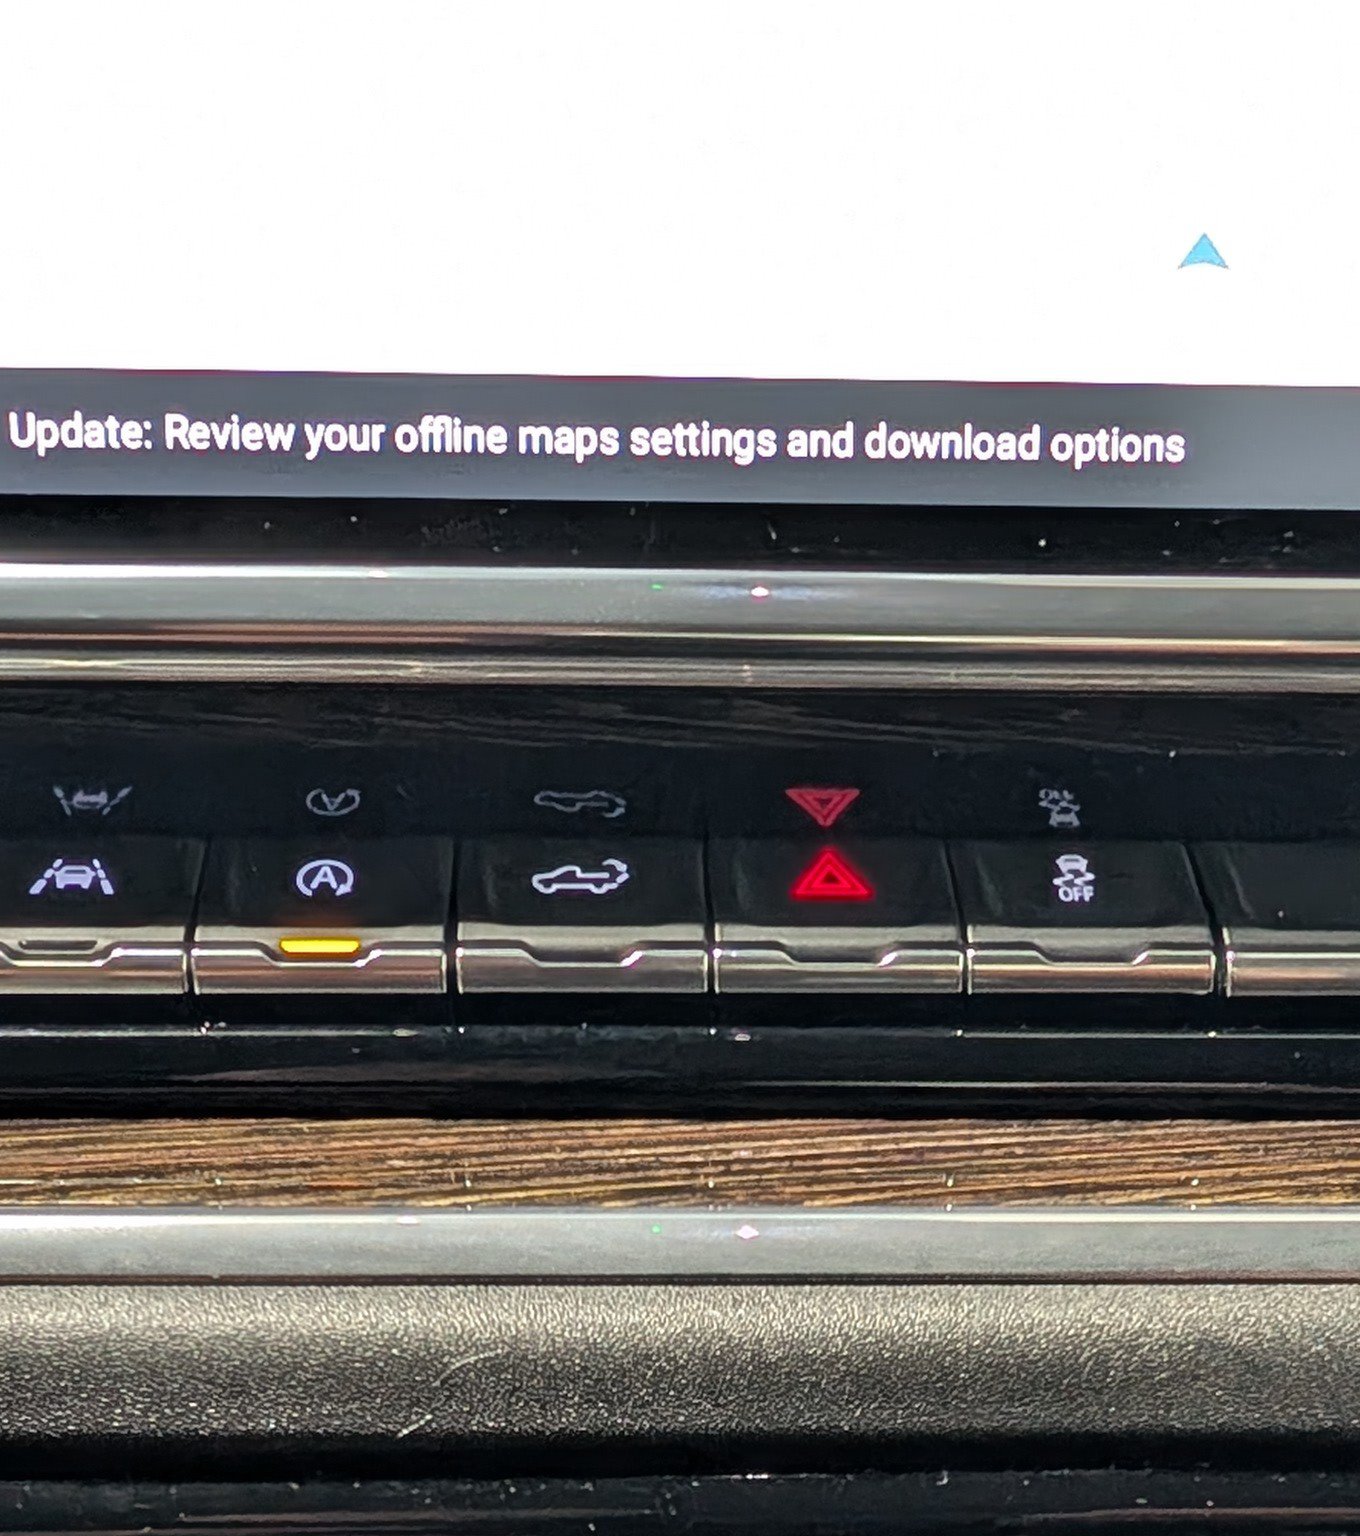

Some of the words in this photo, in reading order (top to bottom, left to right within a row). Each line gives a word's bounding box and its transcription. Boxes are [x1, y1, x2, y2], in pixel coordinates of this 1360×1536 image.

[8, 409, 153, 457] Update:
[164, 412, 297, 452] Review
[303, 422, 387, 461] your
[394, 414, 508, 455] offline
[518, 425, 620, 464] maps
[629, 420, 778, 466] settings
[786, 420, 854, 459] and
[864, 420, 1041, 461] download
[1050, 426, 1186, 471] options
[309, 865, 338, 890] A
[1058, 885, 1094, 902] OFF
